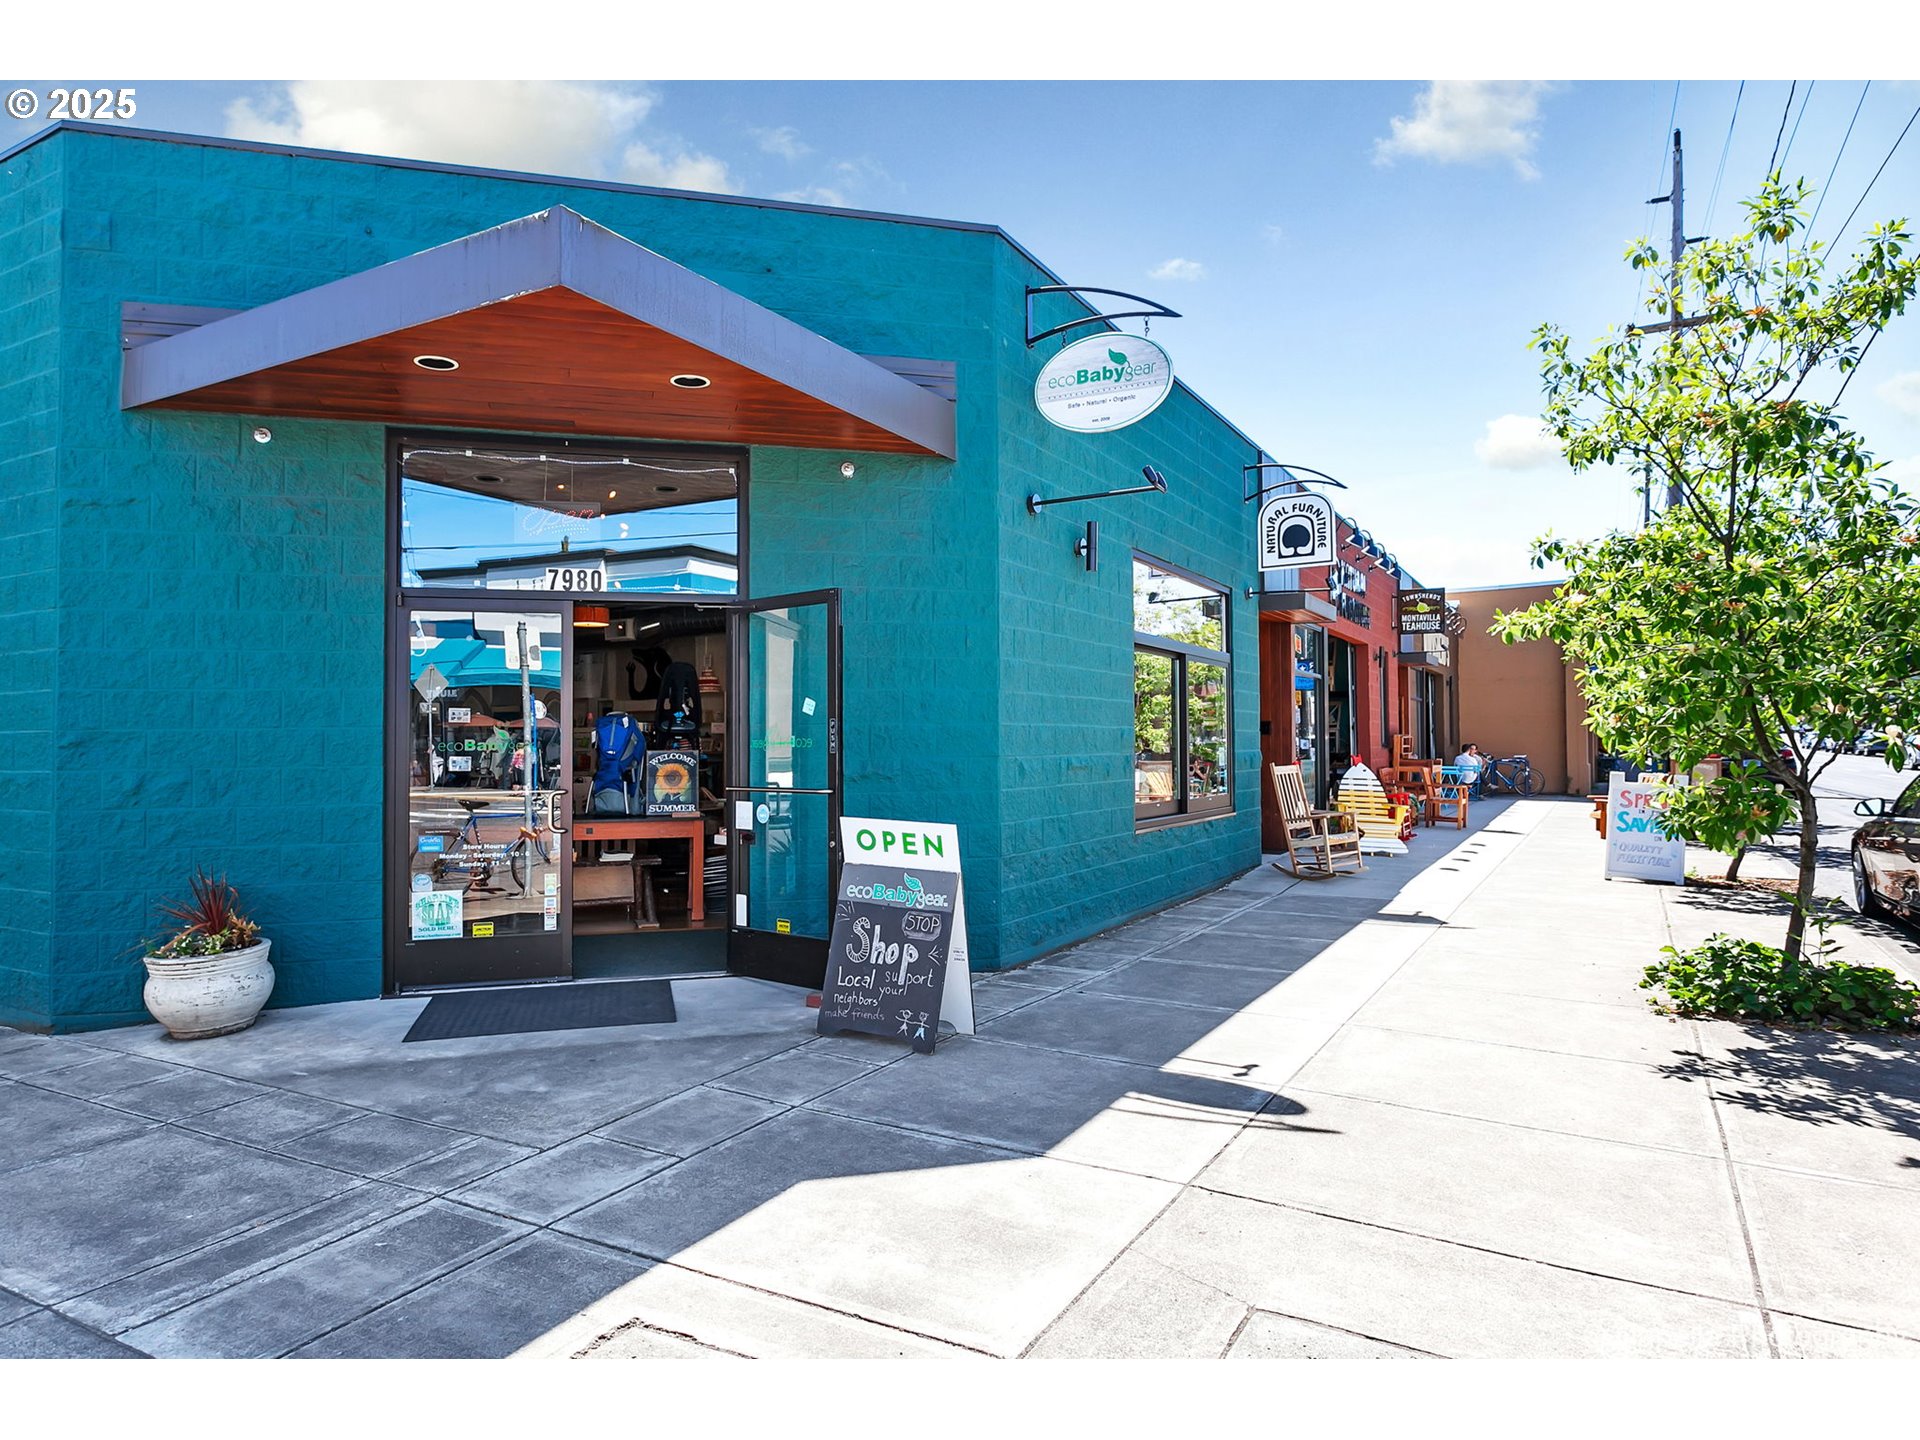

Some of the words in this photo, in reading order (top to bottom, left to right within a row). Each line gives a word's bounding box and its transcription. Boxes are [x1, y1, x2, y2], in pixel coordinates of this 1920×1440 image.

[1048, 362, 1157, 389] ecoBabygear
[1086, 398, 1107, 406] Natural
[1113, 394, 1136, 403] Organic
[1266, 506, 1289, 554] NATURAL
[1292, 503, 1327, 548] FURNITURE
[548, 569, 602, 592] 7980
[1401, 613, 1441, 622] MONTAVILLA
[1402, 621, 1441, 631] TEAHOUSE
[438, 739, 533, 754] ecoBabyge
[649, 752, 697, 767] WELCOME
[648, 804, 696, 812] SUMMER
[1620, 789, 1668, 809] SPR
[856, 829, 944, 858] OPEN
[905, 915, 940, 933] STOP
[845, 916, 919, 985] Shop
[838, 965, 876, 989] Local
[885, 968, 934, 996] suport
[833, 991, 878, 1013] neighbors
[879, 986, 904, 1001] your
[825, 1006, 848, 1018] make
[851, 1007, 885, 1021] friends
